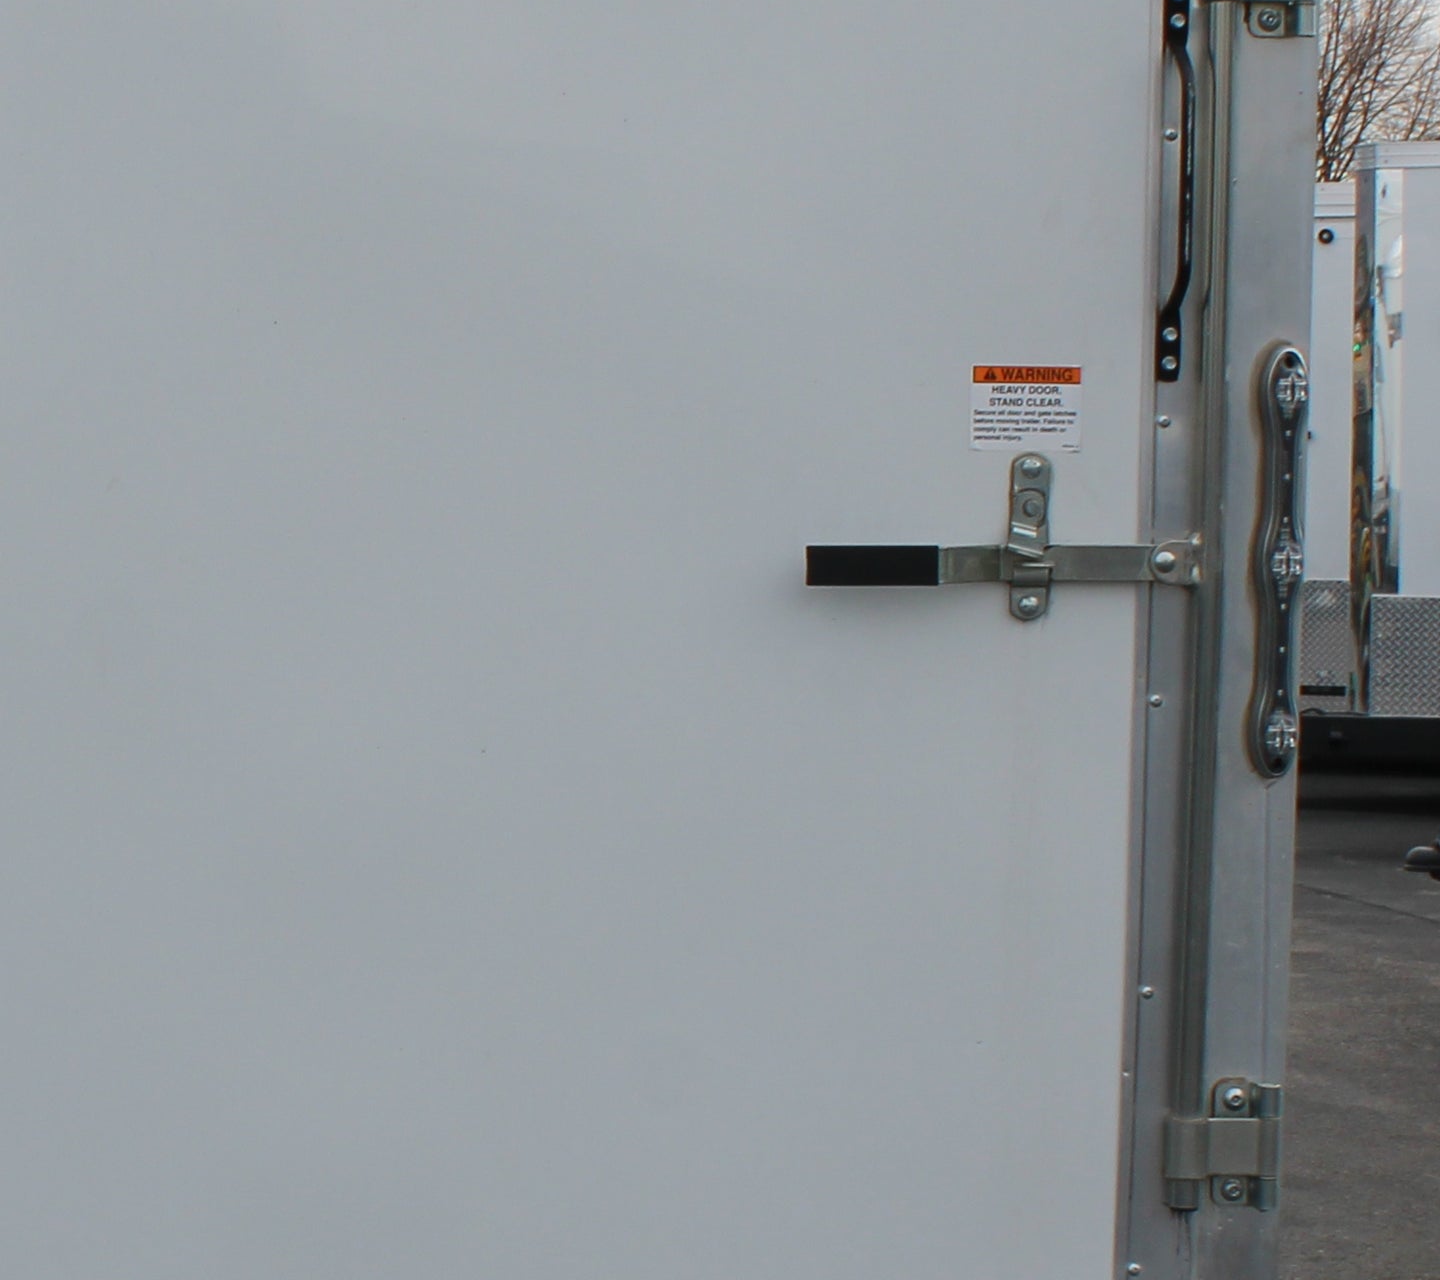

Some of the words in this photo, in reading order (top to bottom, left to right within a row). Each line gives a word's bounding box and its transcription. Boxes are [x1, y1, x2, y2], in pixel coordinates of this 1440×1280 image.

[1001, 368, 1072, 381] WARNING
[991, 386, 1026, 394] HEAVY
[1028, 387, 1062, 395] DOOR.
[989, 398, 1023, 407] STAND
[1026, 399, 1064, 407] CLEAR.
